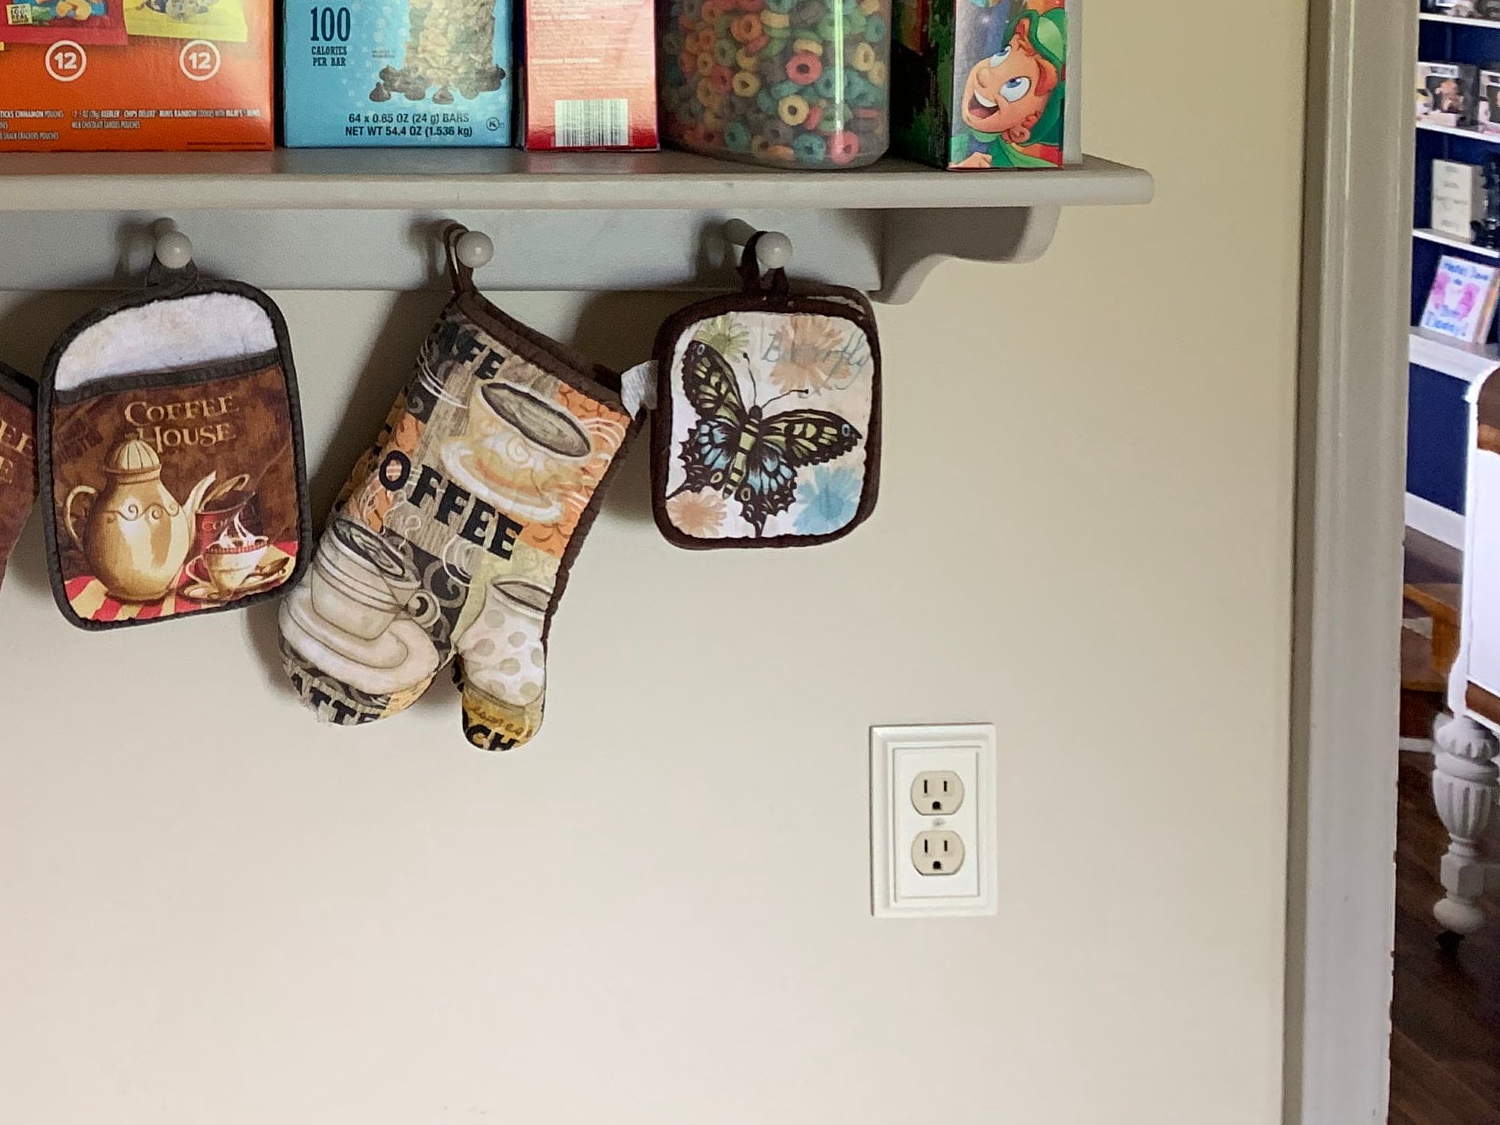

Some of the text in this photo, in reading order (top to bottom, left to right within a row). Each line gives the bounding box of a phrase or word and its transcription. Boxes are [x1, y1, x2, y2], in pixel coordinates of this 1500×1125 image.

[310, 6, 351, 42] 100
[311, 45, 348, 55] CALORIES
[54, 52, 78, 70] 12
[188, 51, 212, 69] 12
[312, 56, 347, 66] PER BAR
[348, 113, 470, 125] 64 x 0.85 OZ (24 g) BARS
[345, 126, 473, 137] NET WT 54.4 OZ (1.536 kg)
[124, 394, 240, 425] COFFEE
[136, 421, 237, 453] HOUSE
